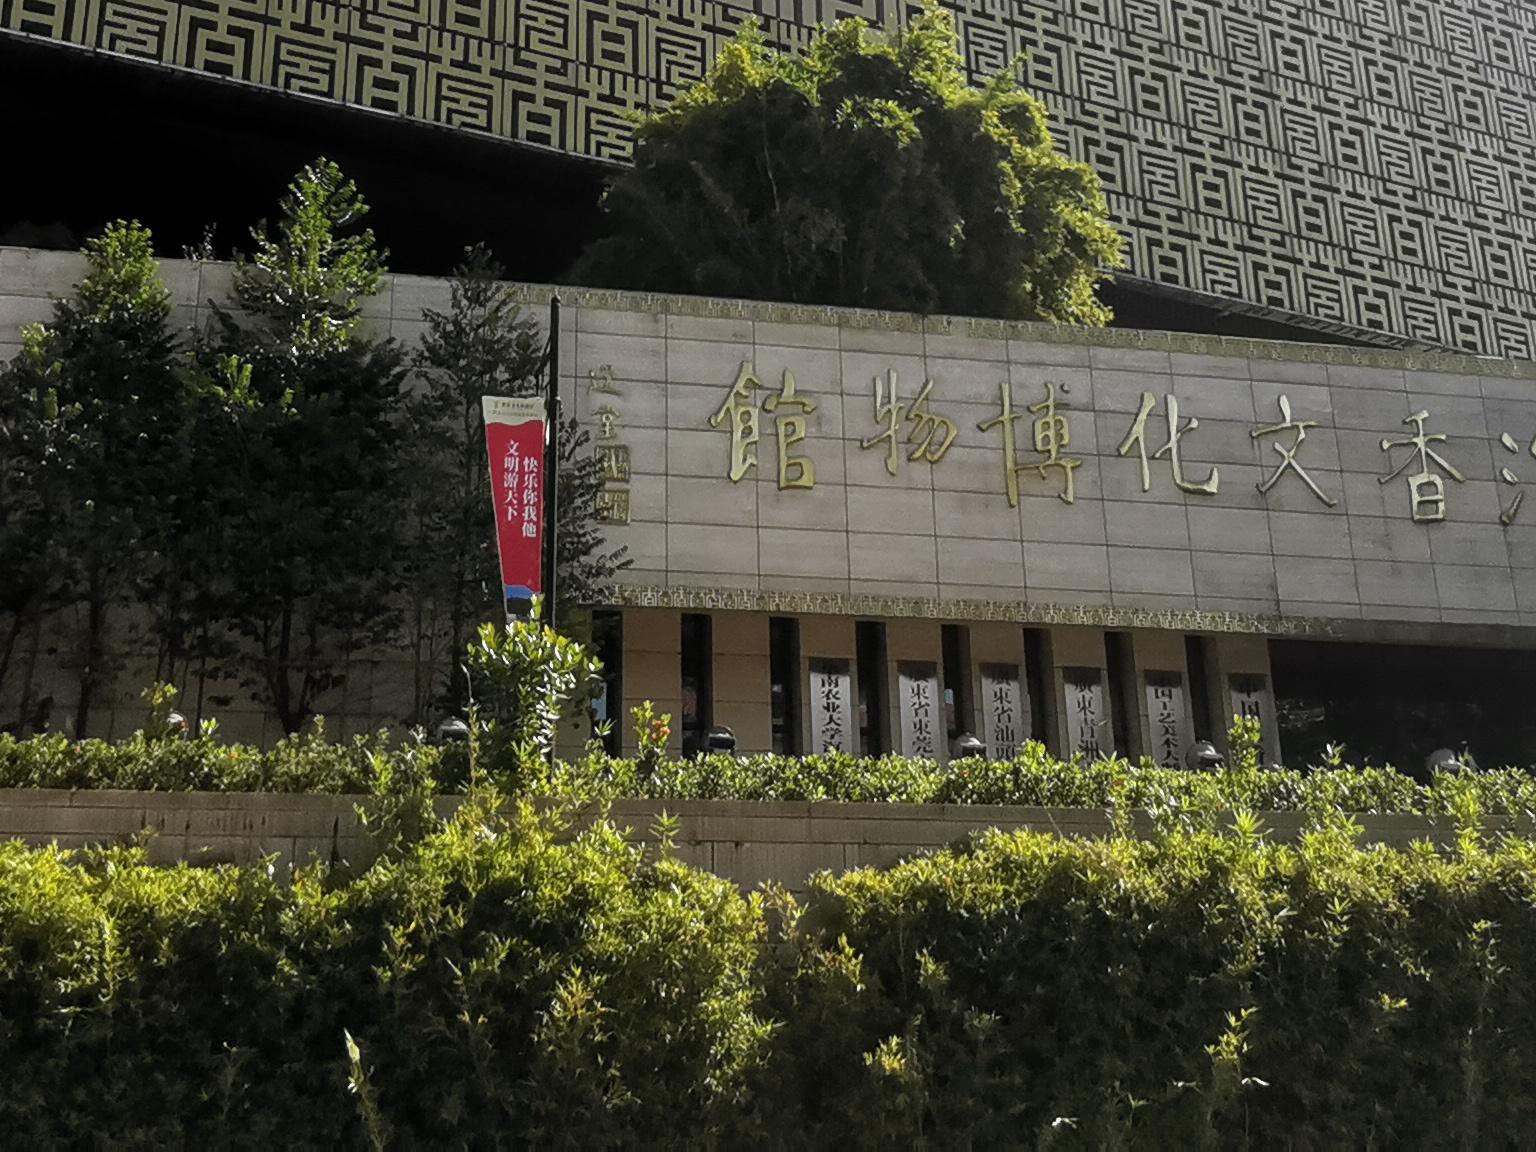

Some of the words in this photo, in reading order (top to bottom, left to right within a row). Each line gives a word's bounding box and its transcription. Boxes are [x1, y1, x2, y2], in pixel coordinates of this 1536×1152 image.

[503, 440, 519, 522] 文明游天下
[522, 456, 539, 538] 快乐你我他
[820, 665, 843, 752] 南农业大学
[910, 669, 935, 756] 東省東莞
